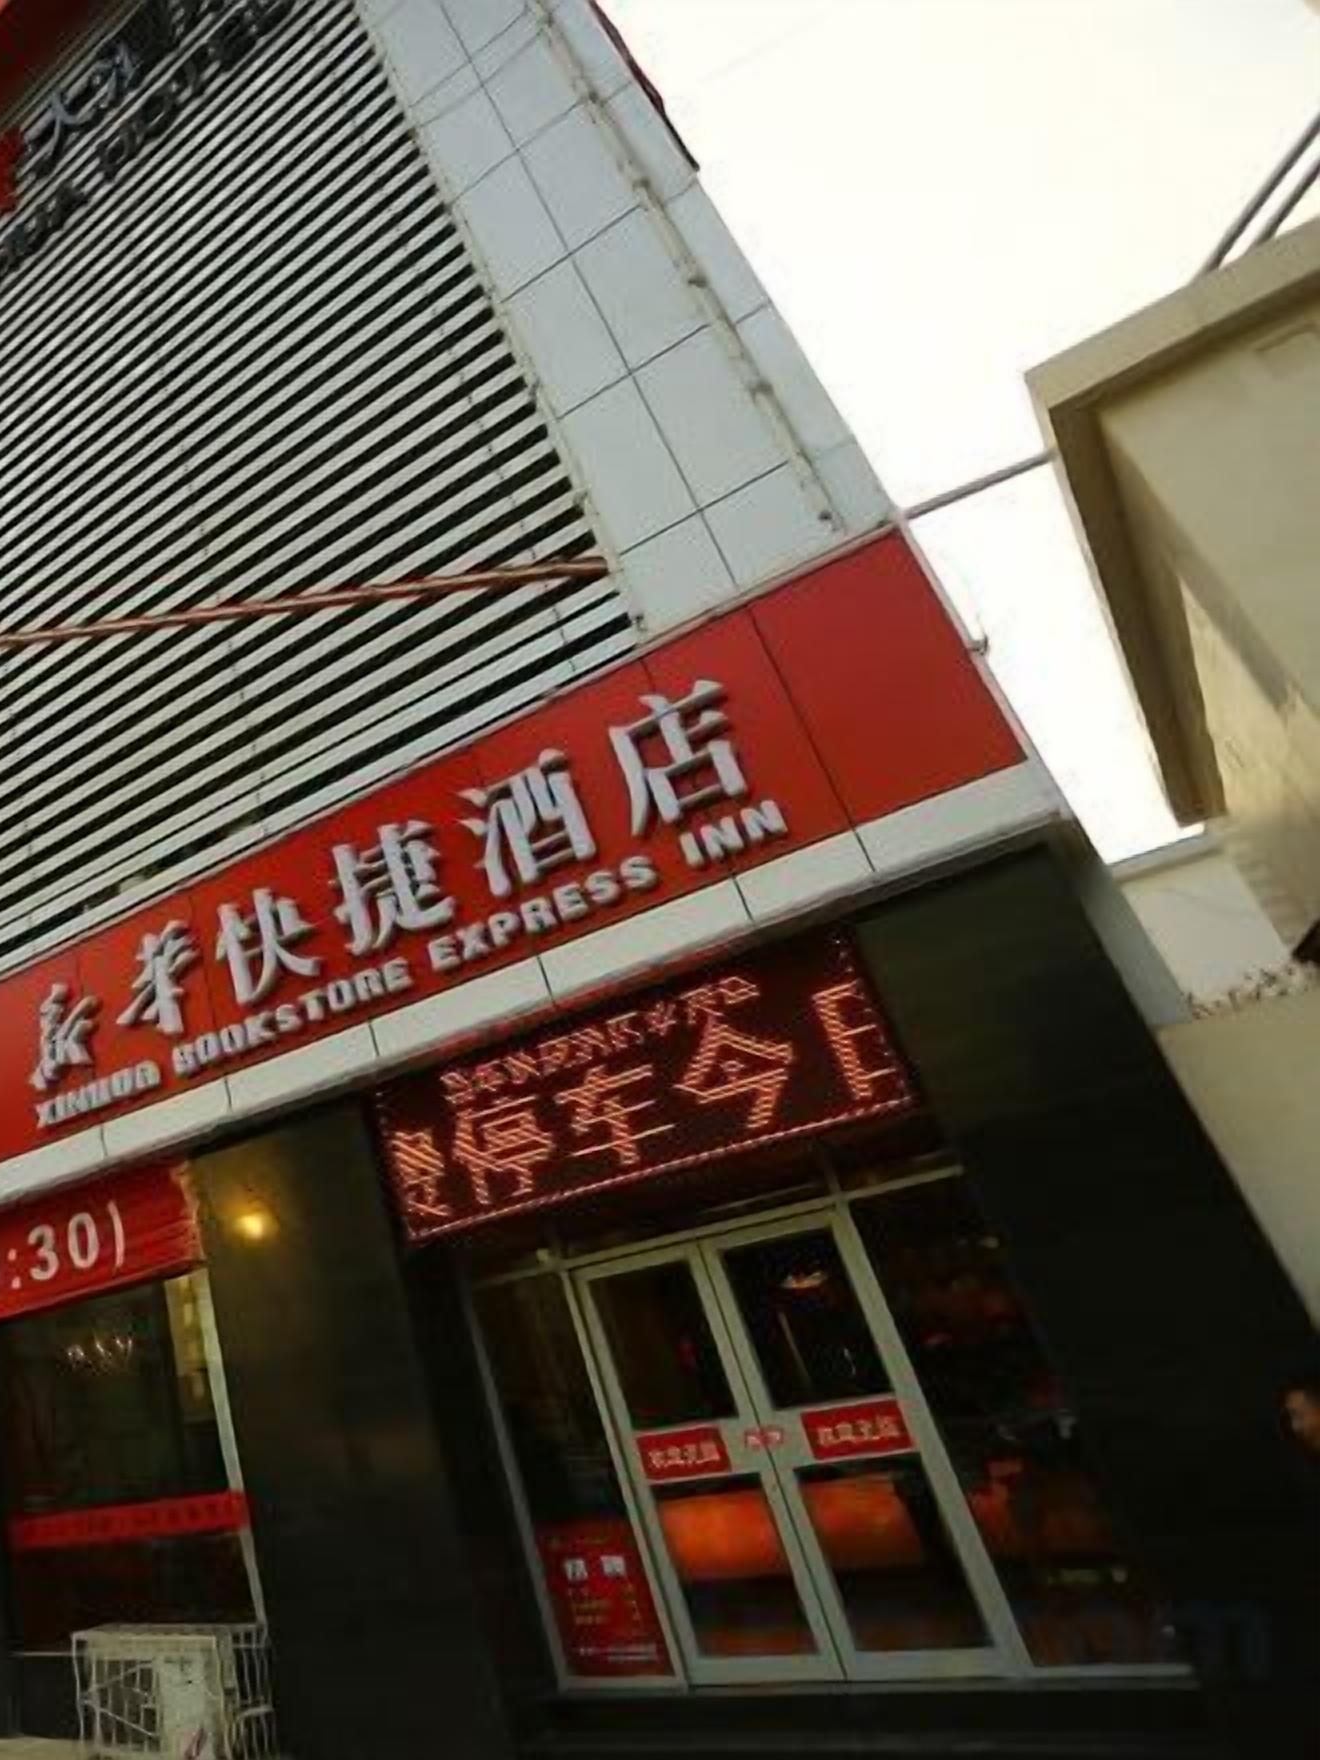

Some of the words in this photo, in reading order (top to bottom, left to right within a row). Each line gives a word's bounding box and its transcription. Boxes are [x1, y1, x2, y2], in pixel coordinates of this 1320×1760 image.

[171, 957, 412, 1076] BOOKSTORE
[429, 854, 659, 972] EXPRESS
[680, 799, 789, 866] INN
